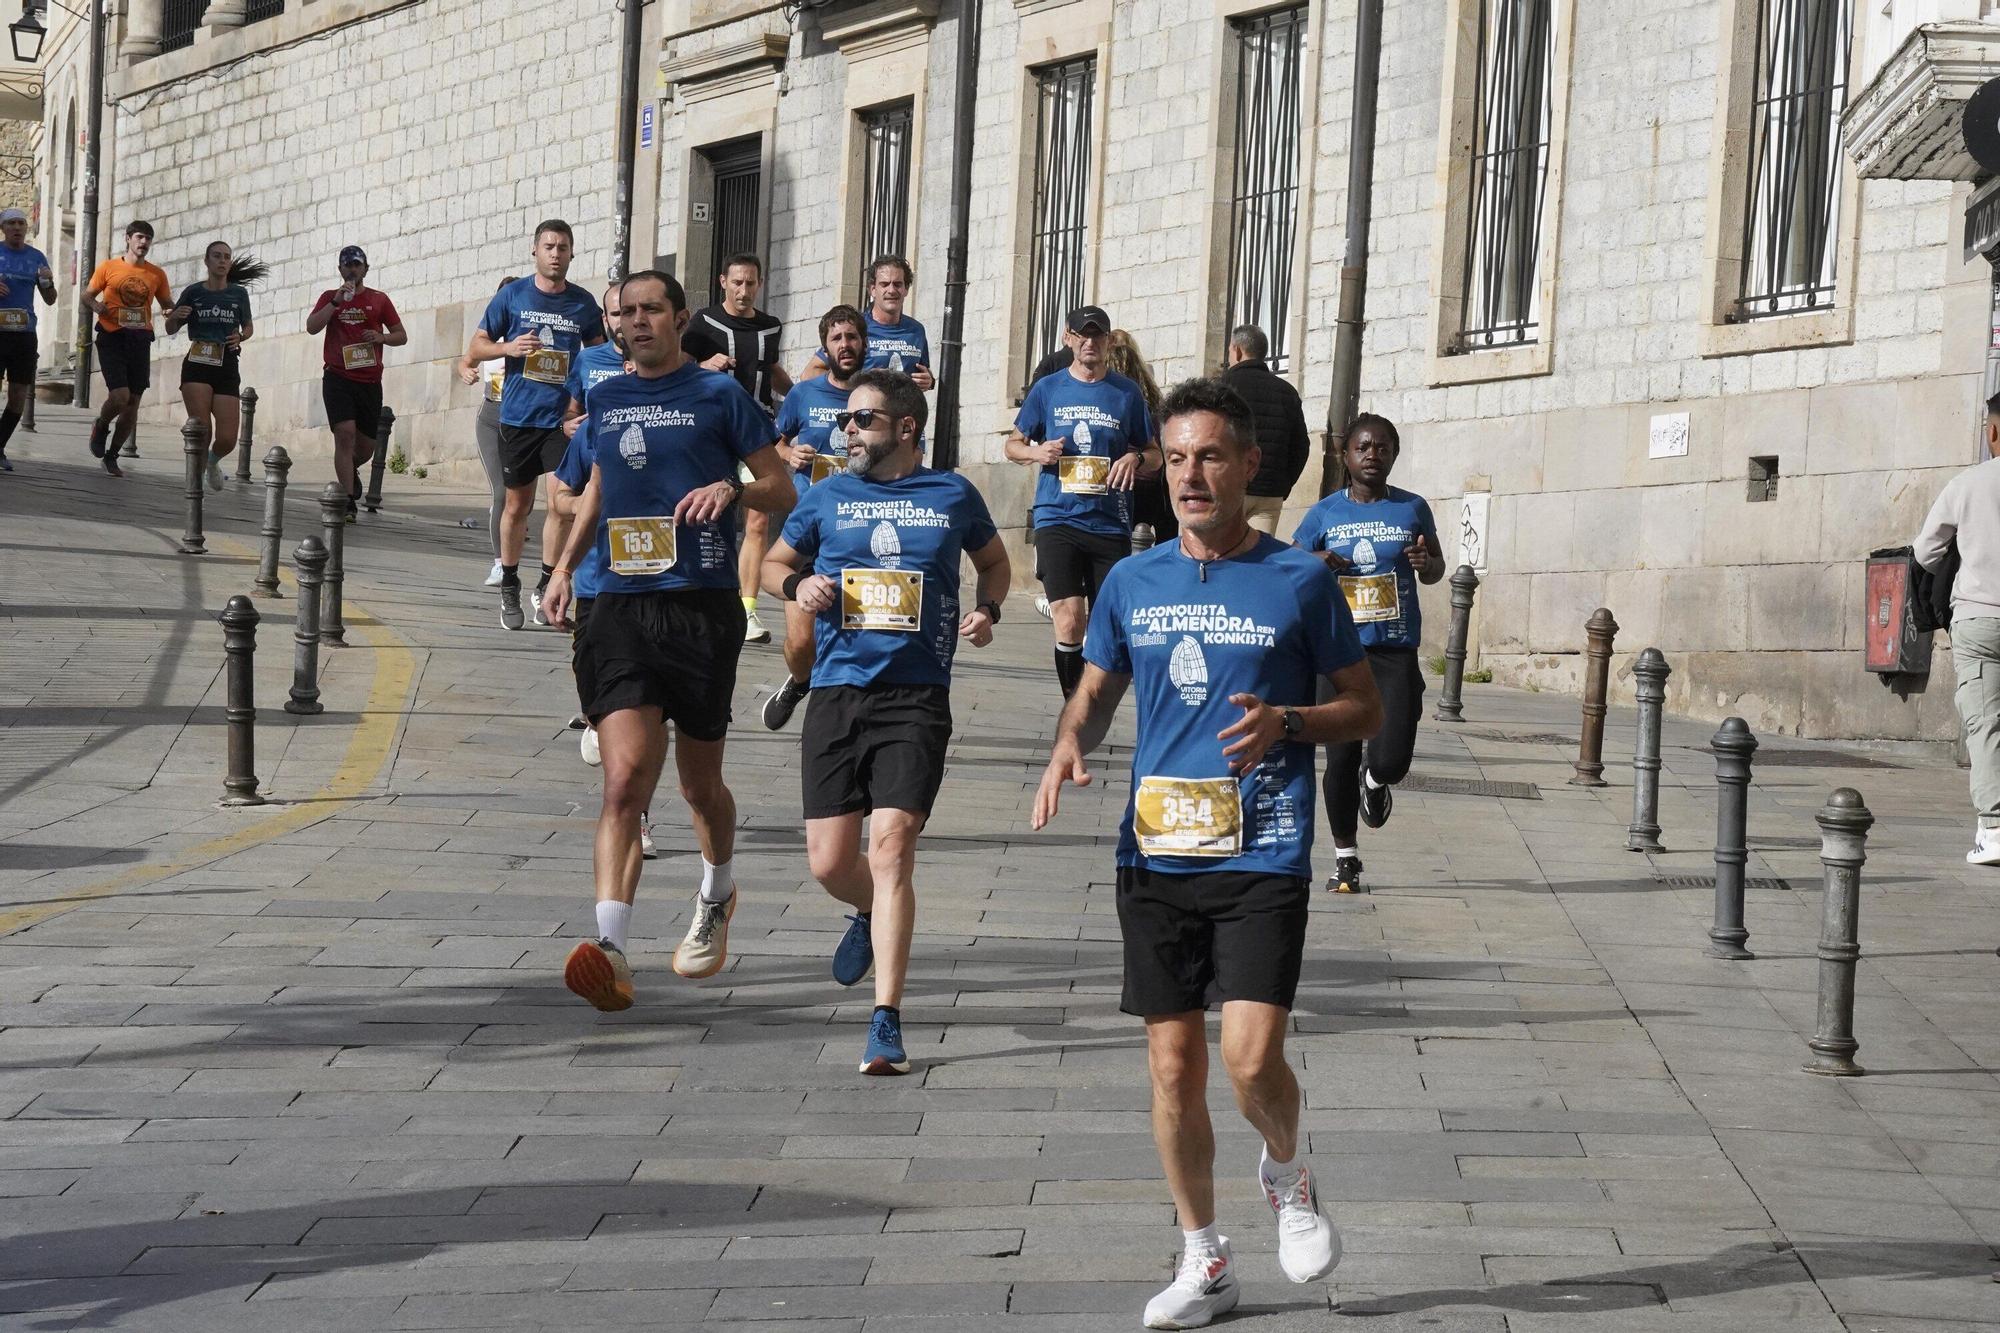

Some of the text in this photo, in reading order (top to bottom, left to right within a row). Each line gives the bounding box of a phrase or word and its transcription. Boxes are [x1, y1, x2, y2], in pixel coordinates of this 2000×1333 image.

[530, 316, 574, 326] ALMENDRA
[537, 358, 559, 371] 404
[610, 410, 680, 424] ALMENDRA
[611, 405, 662, 416] CONQUISTA
[1063, 412, 1112, 421] ALMENDRA
[644, 418, 695, 428] KONKISTA
[851, 500, 913, 510] CONQUISTA
[853, 508, 936, 519] ALMENDRA
[898, 519, 950, 528] KONKISTA
[1336, 521, 1385, 531] CONQUISTA
[1338, 526, 1403, 539] ALMENDRA
[1373, 534, 1412, 542] KONKISTA
[622, 532, 653, 553] 153
[861, 584, 901, 607] 698
[1354, 587, 1379, 605] 112
[1133, 605, 1227, 618] LA CONQUISTA
[1148, 617, 1256, 632] ALMENDRA
[1256, 626, 1275, 634] REN
[1204, 632, 1275, 647] KONKISTA
[1162, 797, 1213, 827] 354
